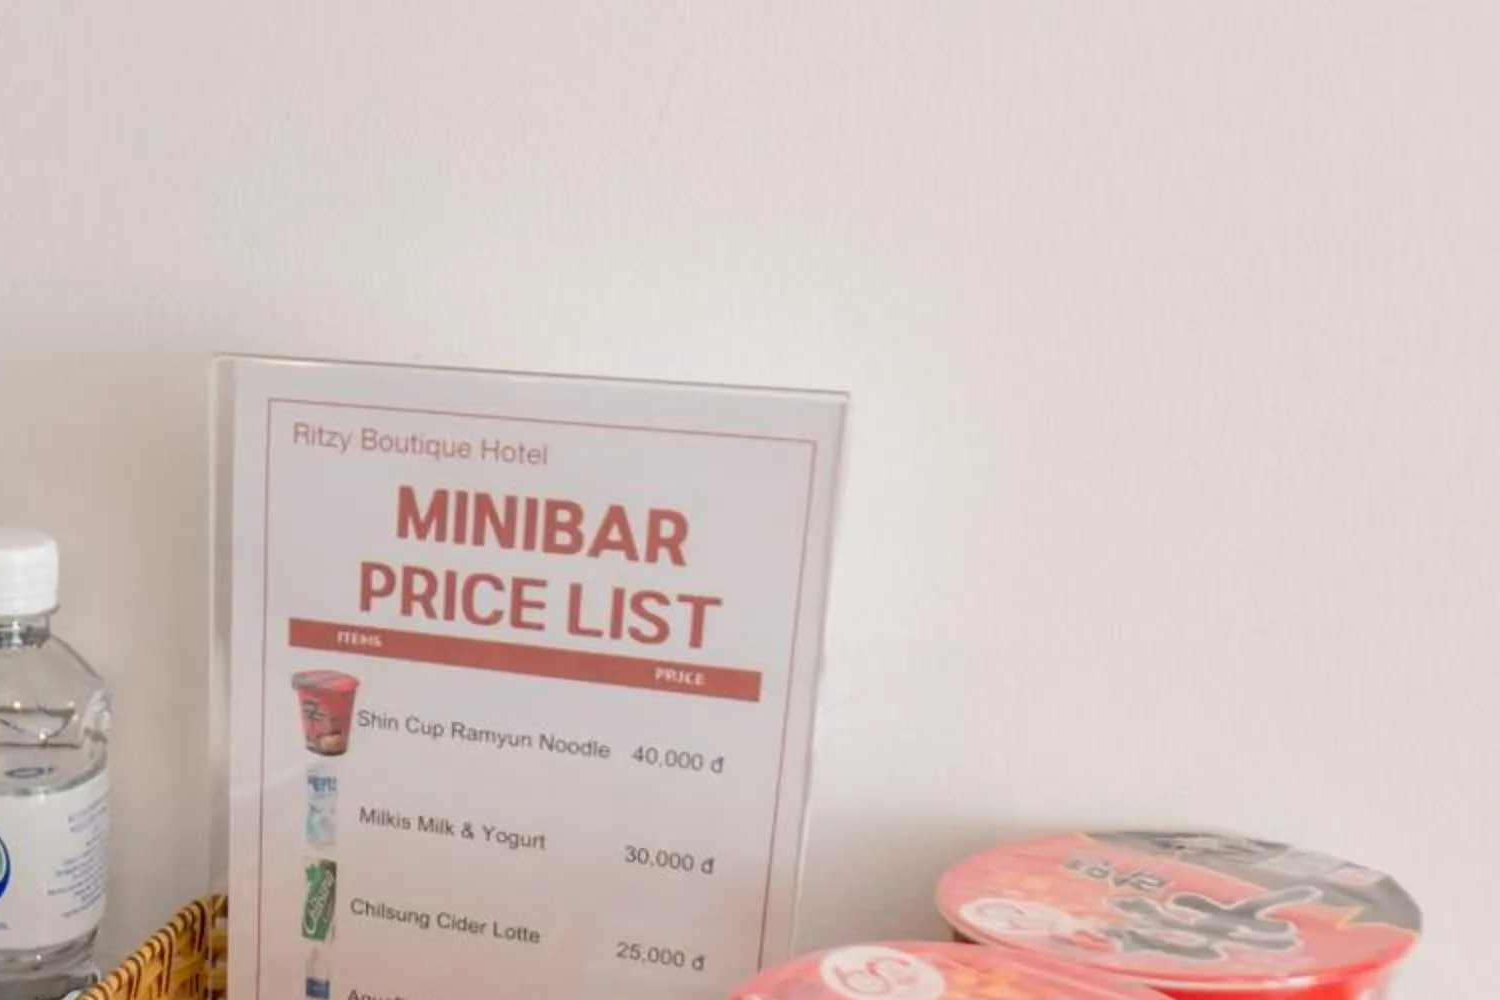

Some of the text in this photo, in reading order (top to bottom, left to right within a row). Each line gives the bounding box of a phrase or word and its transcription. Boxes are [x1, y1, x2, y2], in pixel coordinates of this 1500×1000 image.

[293, 421, 548, 465] Ritzy Boutique Hotel
[396, 485, 689, 566] MINIBAR
[359, 561, 723, 649] PRICE LIST
[357, 709, 611, 759] Shin Cup Ramyun Noodle
[359, 806, 546, 850] Milkis Milk & Yogurt
[350, 898, 541, 944] Chilsung Cider Lotte
